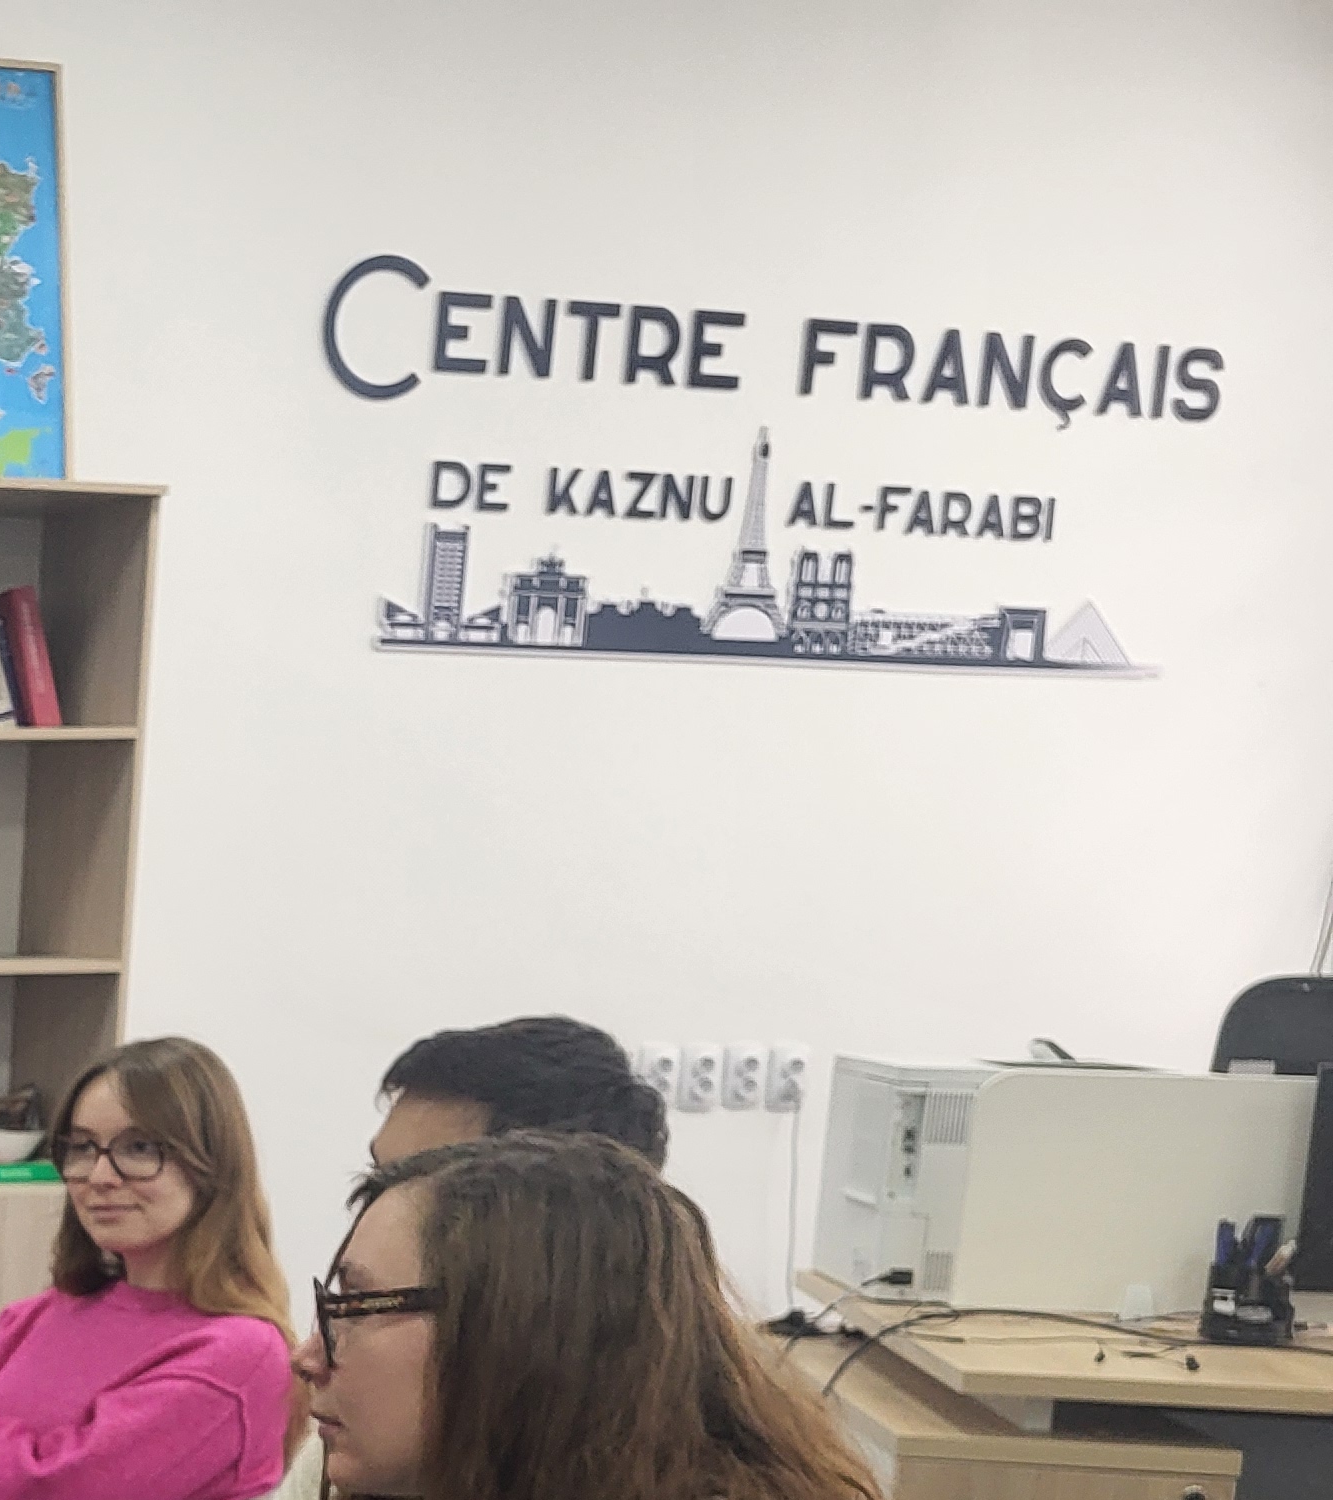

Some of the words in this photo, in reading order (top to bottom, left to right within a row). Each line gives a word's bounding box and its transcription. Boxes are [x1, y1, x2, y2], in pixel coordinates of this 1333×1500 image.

[321, 254, 747, 402] CENTRE
[798, 318, 1226, 429] FRANÇAIS
[430, 460, 512, 513] DE
[545, 466, 734, 524] KAZNU
[786, 481, 1057, 542] AL-FARABI
